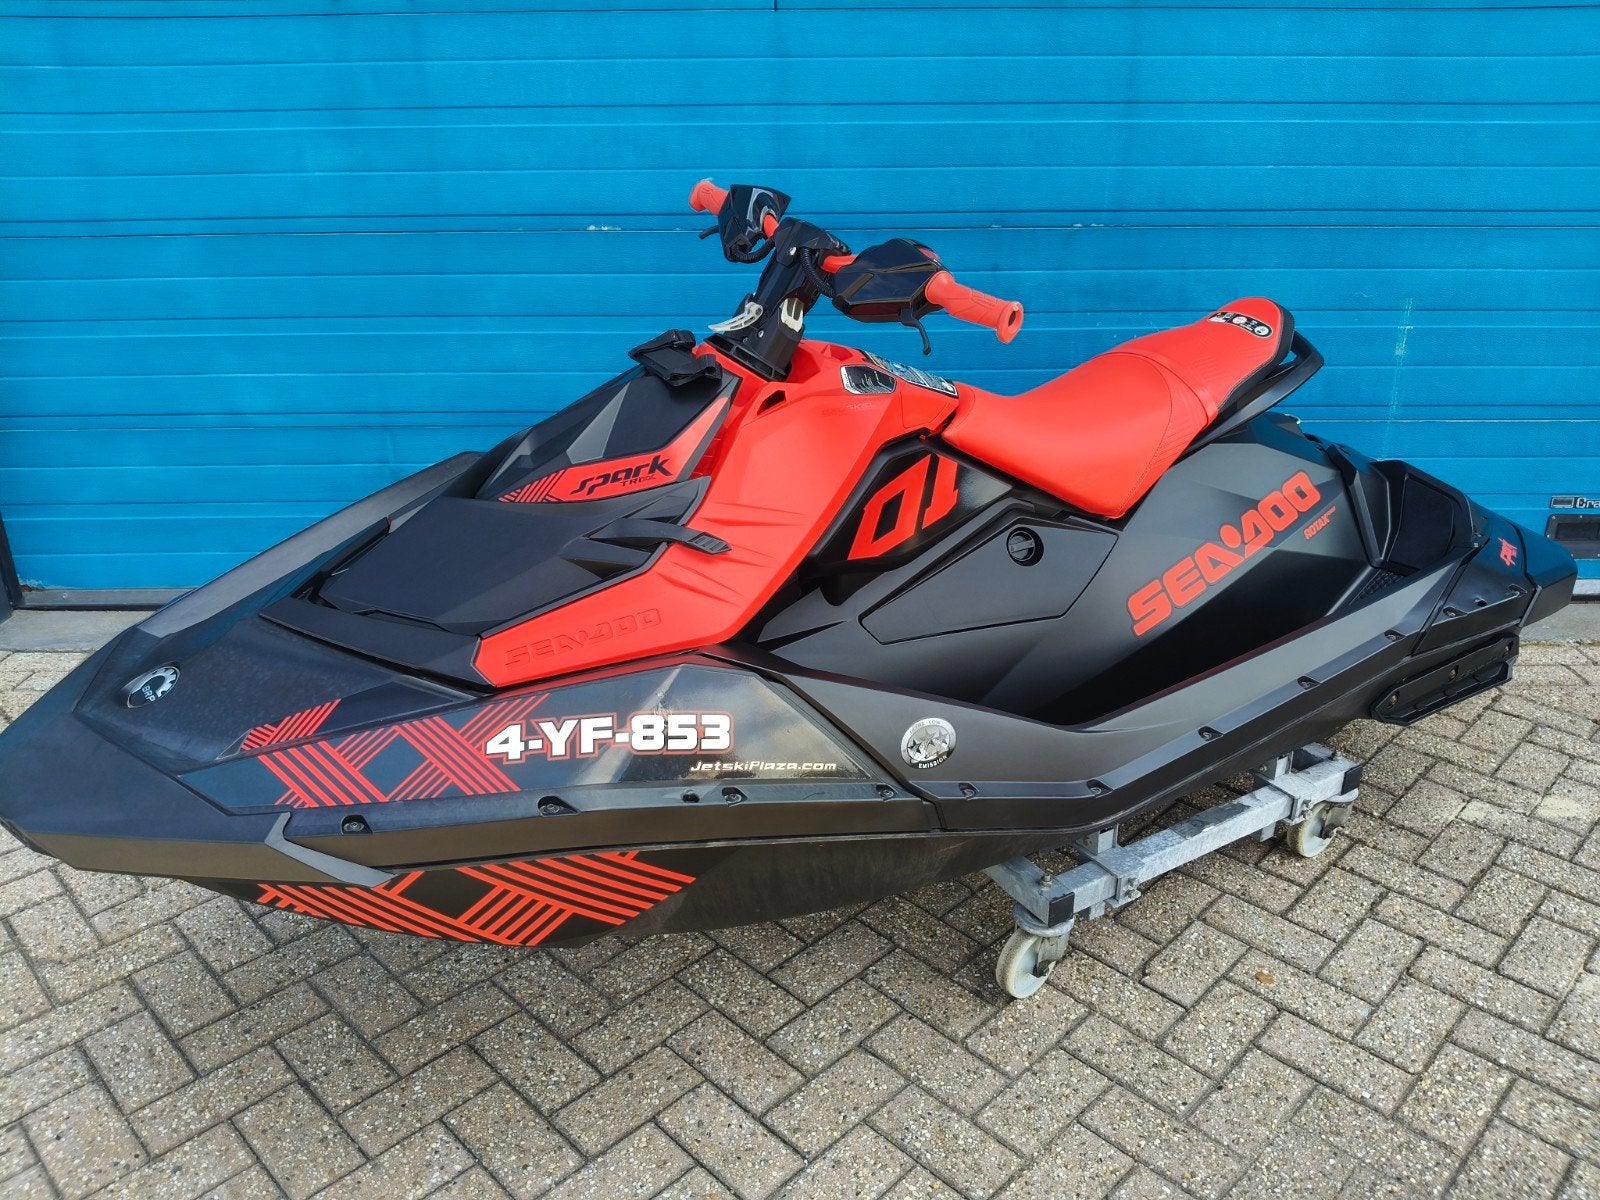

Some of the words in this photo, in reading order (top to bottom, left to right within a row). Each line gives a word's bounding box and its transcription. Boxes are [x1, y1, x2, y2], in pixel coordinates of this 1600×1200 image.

[142, 685, 155, 701] BRP
[485, 712, 732, 762] 4-YF-853
[690, 760, 837, 772] JetskiPlaza.com
